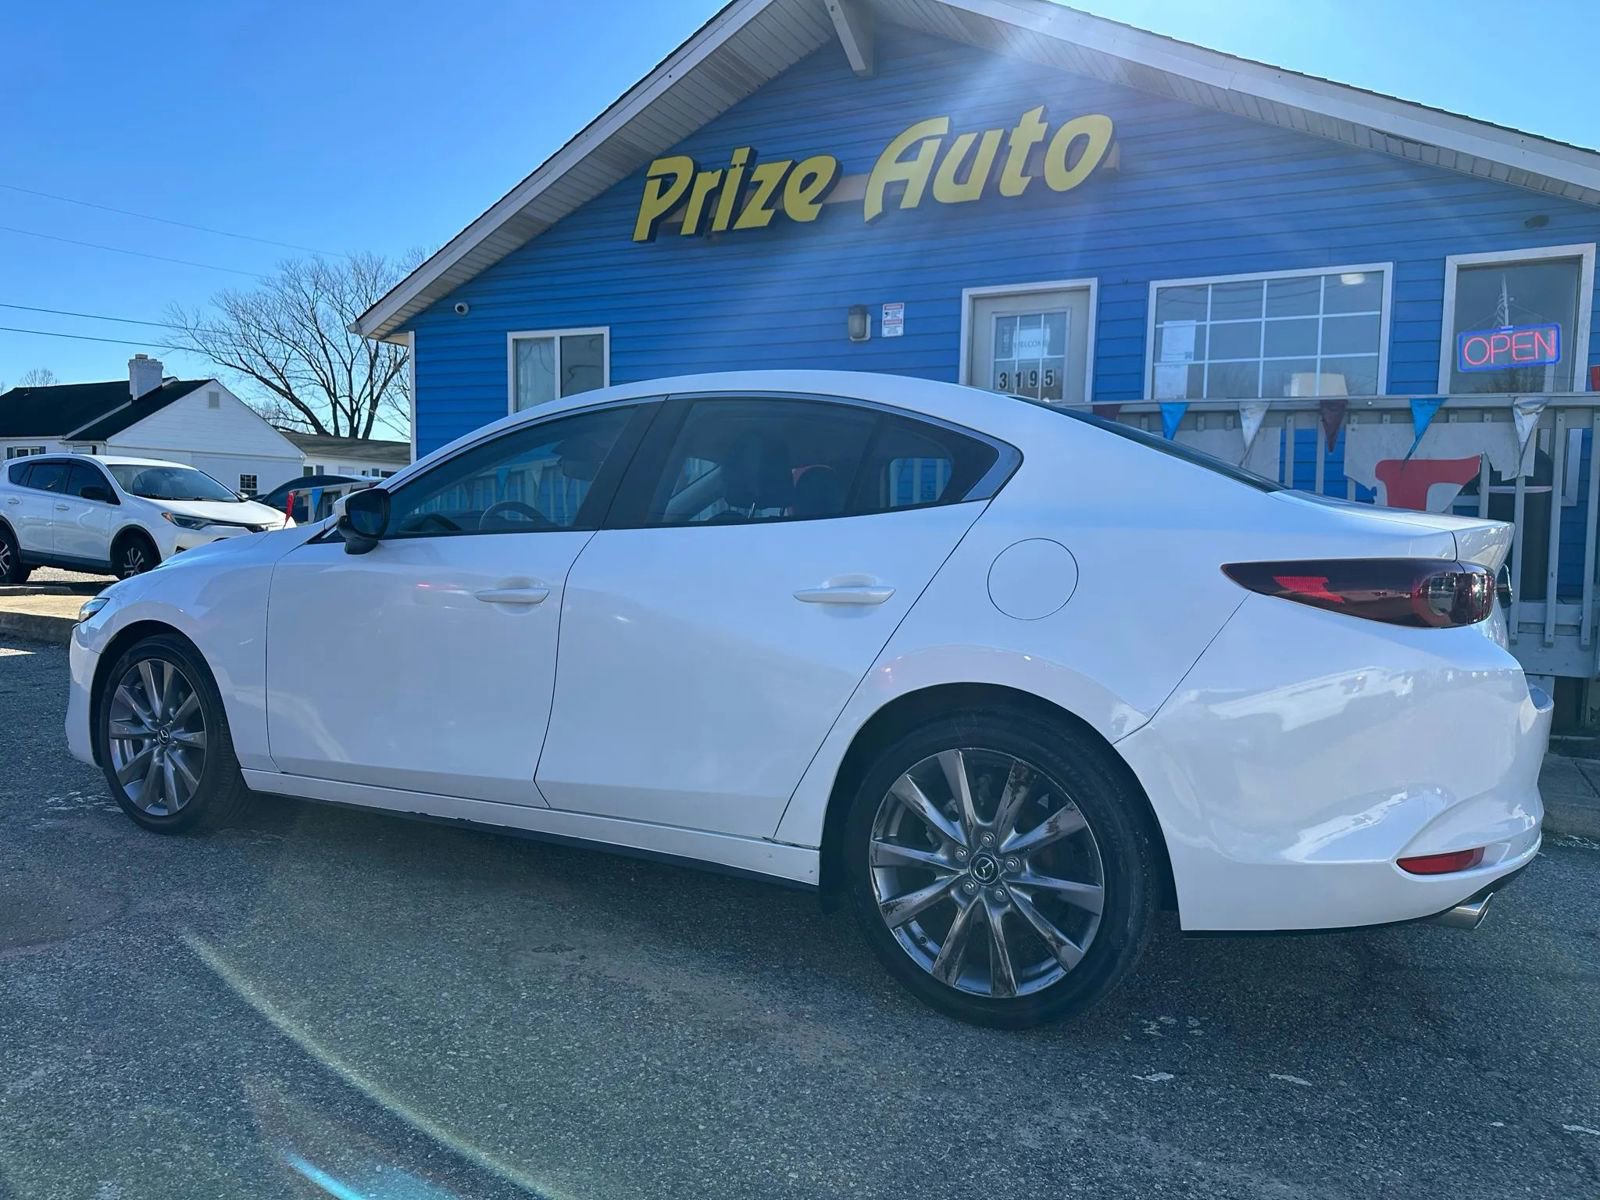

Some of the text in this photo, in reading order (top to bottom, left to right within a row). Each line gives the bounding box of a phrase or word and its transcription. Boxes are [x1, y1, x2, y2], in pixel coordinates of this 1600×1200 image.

[633, 105, 1114, 242] Prize Auto
[1464, 330, 1555, 365] OPEN
[999, 369, 1054, 388] 3195
